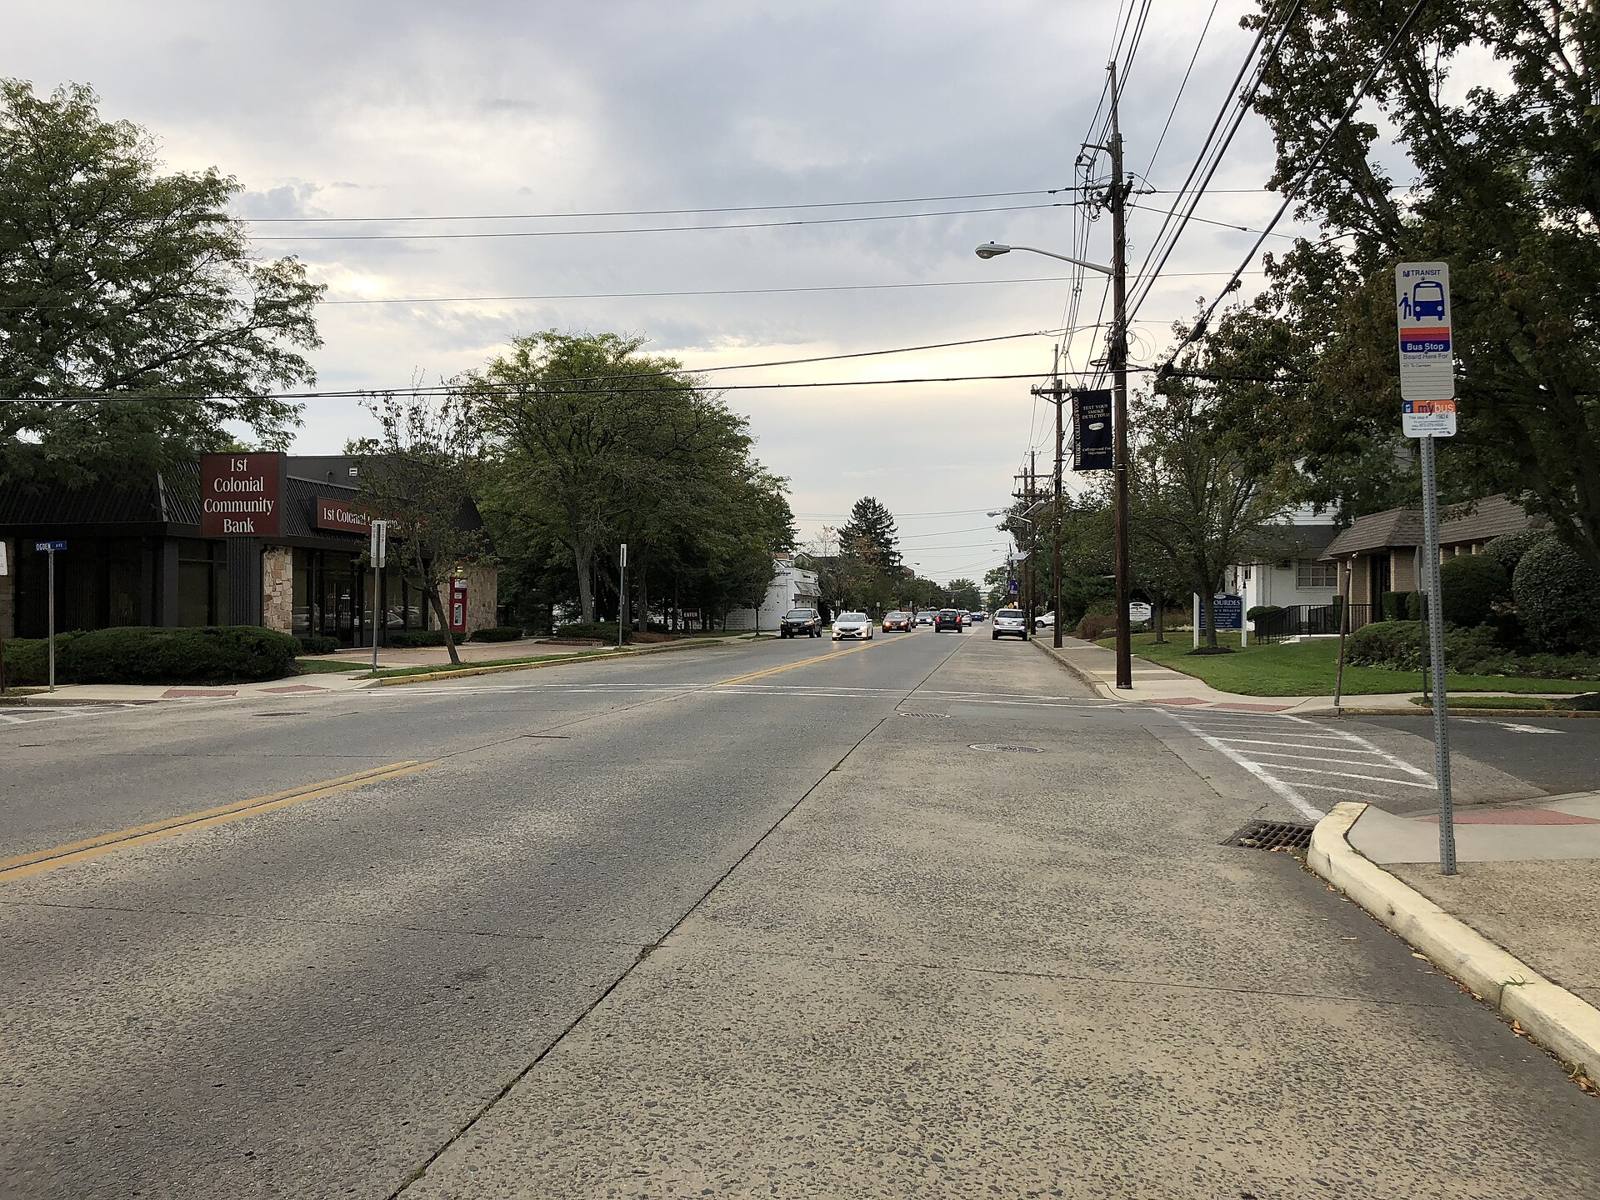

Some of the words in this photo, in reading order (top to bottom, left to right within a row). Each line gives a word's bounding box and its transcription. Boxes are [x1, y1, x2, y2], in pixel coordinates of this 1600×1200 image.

[1406, 343, 1423, 351] Bus
[1424, 342, 1444, 351] Stop
[1418, 401, 1454, 415] mybus
[1073, 396, 1081, 440] COLLINGSWOOD
[231, 458, 247, 472] 1st
[214, 476, 264, 493] Colonial
[203, 496, 275, 516] Community
[323, 507, 335, 521] 1st
[223, 517, 255, 533] Bank
